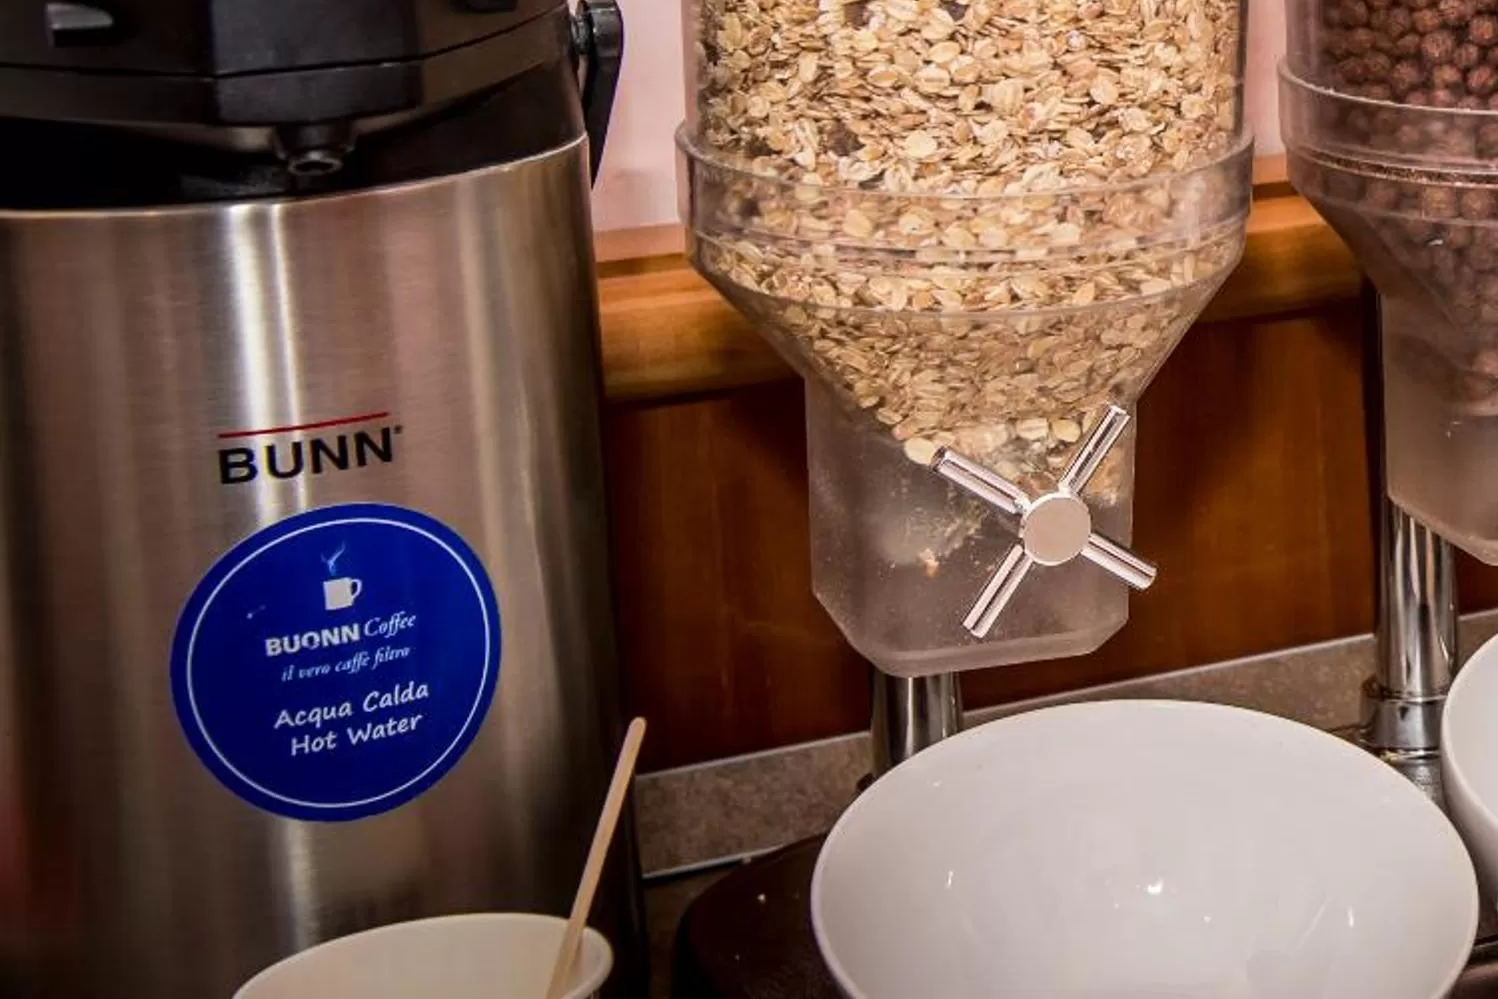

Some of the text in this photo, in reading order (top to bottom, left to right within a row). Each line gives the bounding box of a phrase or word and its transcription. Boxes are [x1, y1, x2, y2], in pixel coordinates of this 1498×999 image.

[218, 427, 396, 485] BUNN
[265, 611, 416, 656] BUONN Coffee
[282, 665, 295, 682] il
[298, 663, 331, 679] vero
[372, 646, 410, 671] filtro
[274, 681, 429, 729] Acqua Calda
[291, 714, 422, 756] Hot Water
